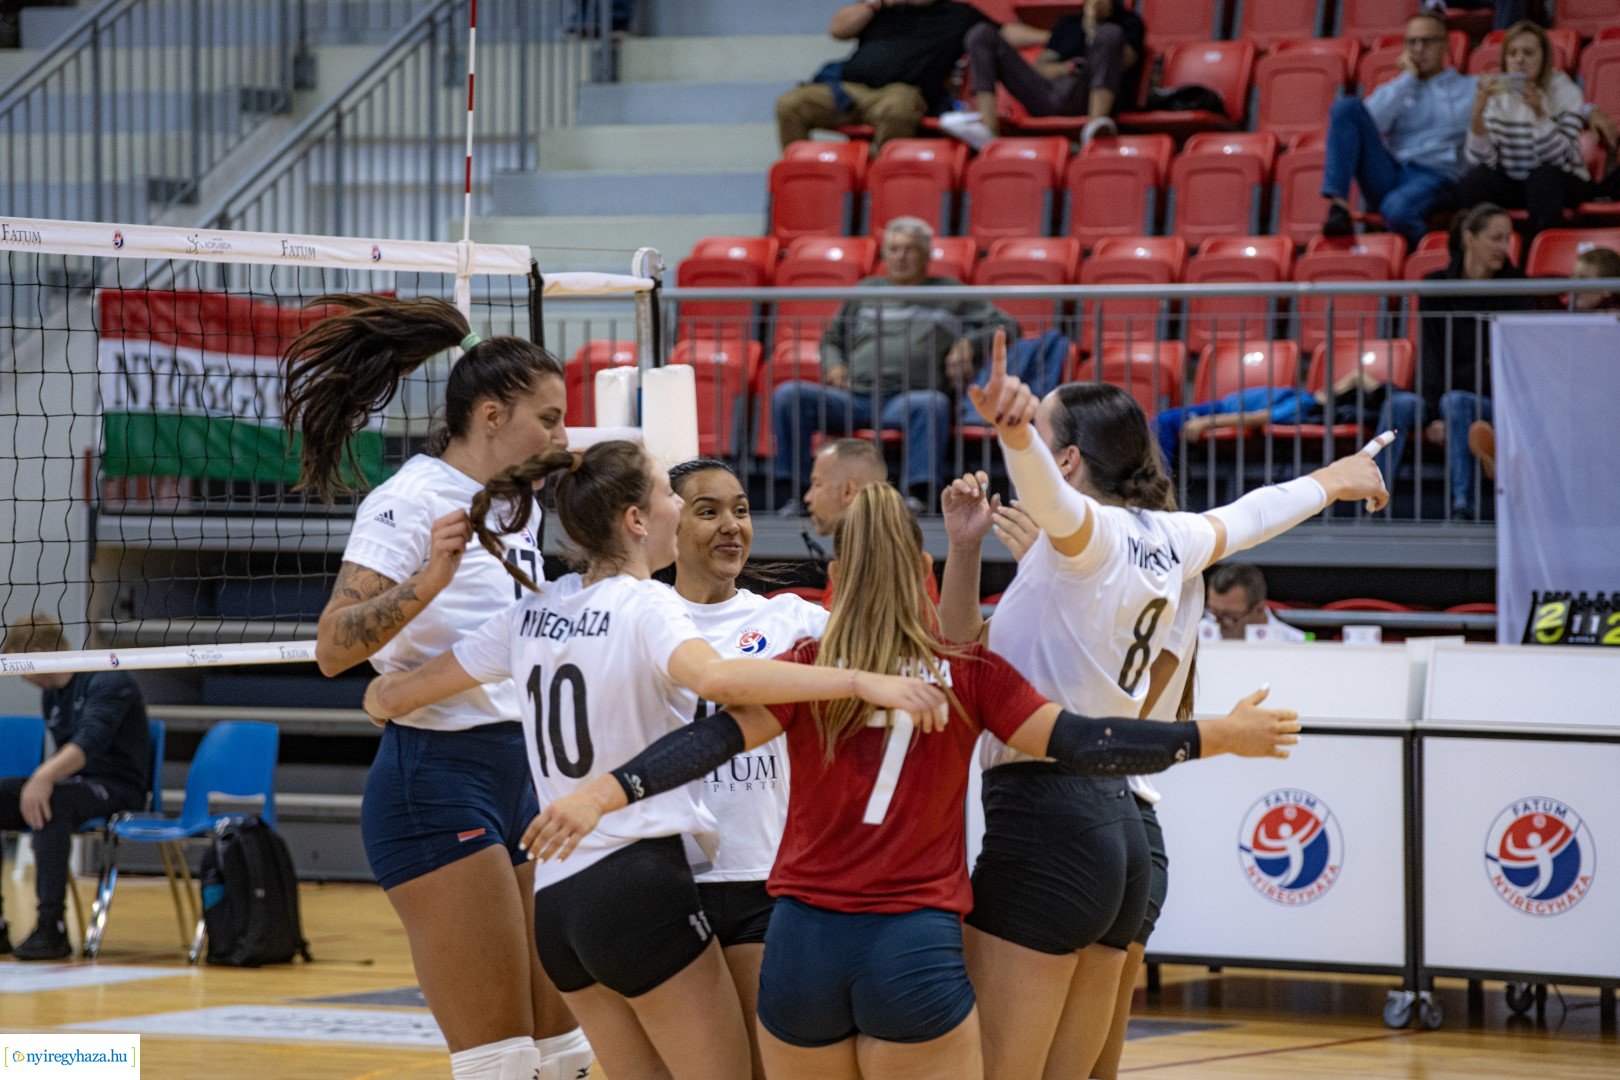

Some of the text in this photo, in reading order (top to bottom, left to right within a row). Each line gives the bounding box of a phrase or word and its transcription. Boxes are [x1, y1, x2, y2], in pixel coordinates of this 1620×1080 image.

[1, 223, 42, 244] FATUM
[281, 240, 316, 258] FATUM
[374, 515, 397, 528] adidas
[279, 645, 309, 660] FATUM
[1118, 597, 1169, 698] 8
[0, 657, 36, 672] FATUM
[526, 663, 596, 779] 10
[861, 708, 915, 826] 7
[1264, 790, 1318, 809] FATUM
[1512, 799, 1568, 818] FATUM
